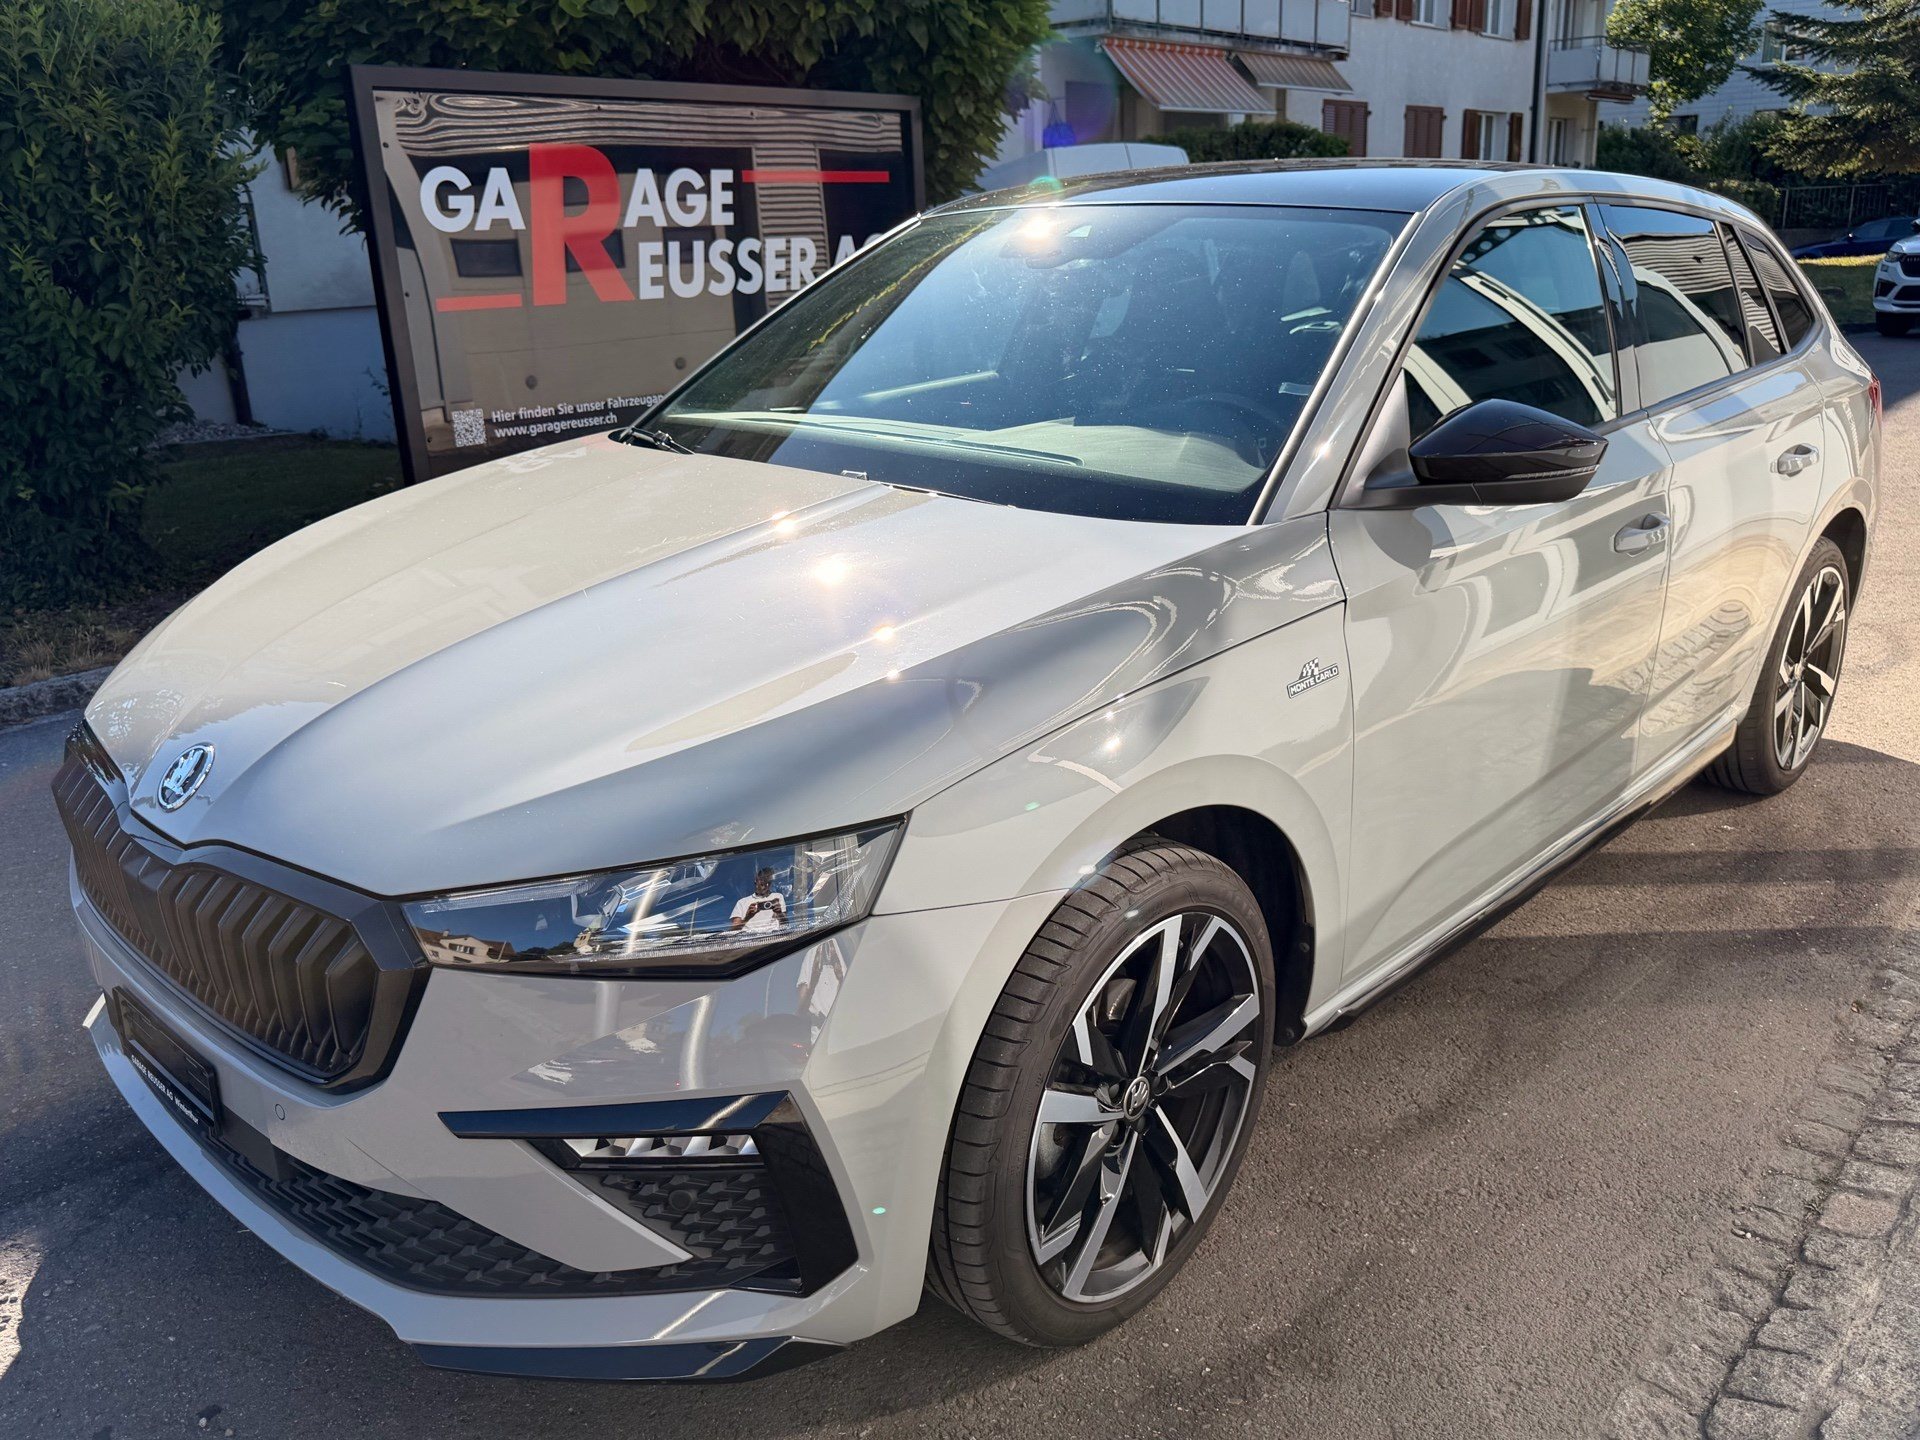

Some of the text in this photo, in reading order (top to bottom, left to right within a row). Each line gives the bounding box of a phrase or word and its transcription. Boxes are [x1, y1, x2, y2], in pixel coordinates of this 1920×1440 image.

[419, 143, 735, 307] GARAGE
[492, 411, 516, 423] Hier
[519, 406, 556, 420] finden
[557, 402, 575, 415] Sie
[577, 401, 606, 413] unser
[494, 412, 618, 438] www.garagereusser.ch
[1290, 667, 1338, 695] MONTE CARLO
[131, 1054, 147, 1075] GARAGE
[147, 1070, 167, 1094] REUSSER
[166, 1088, 174, 1101] AG
